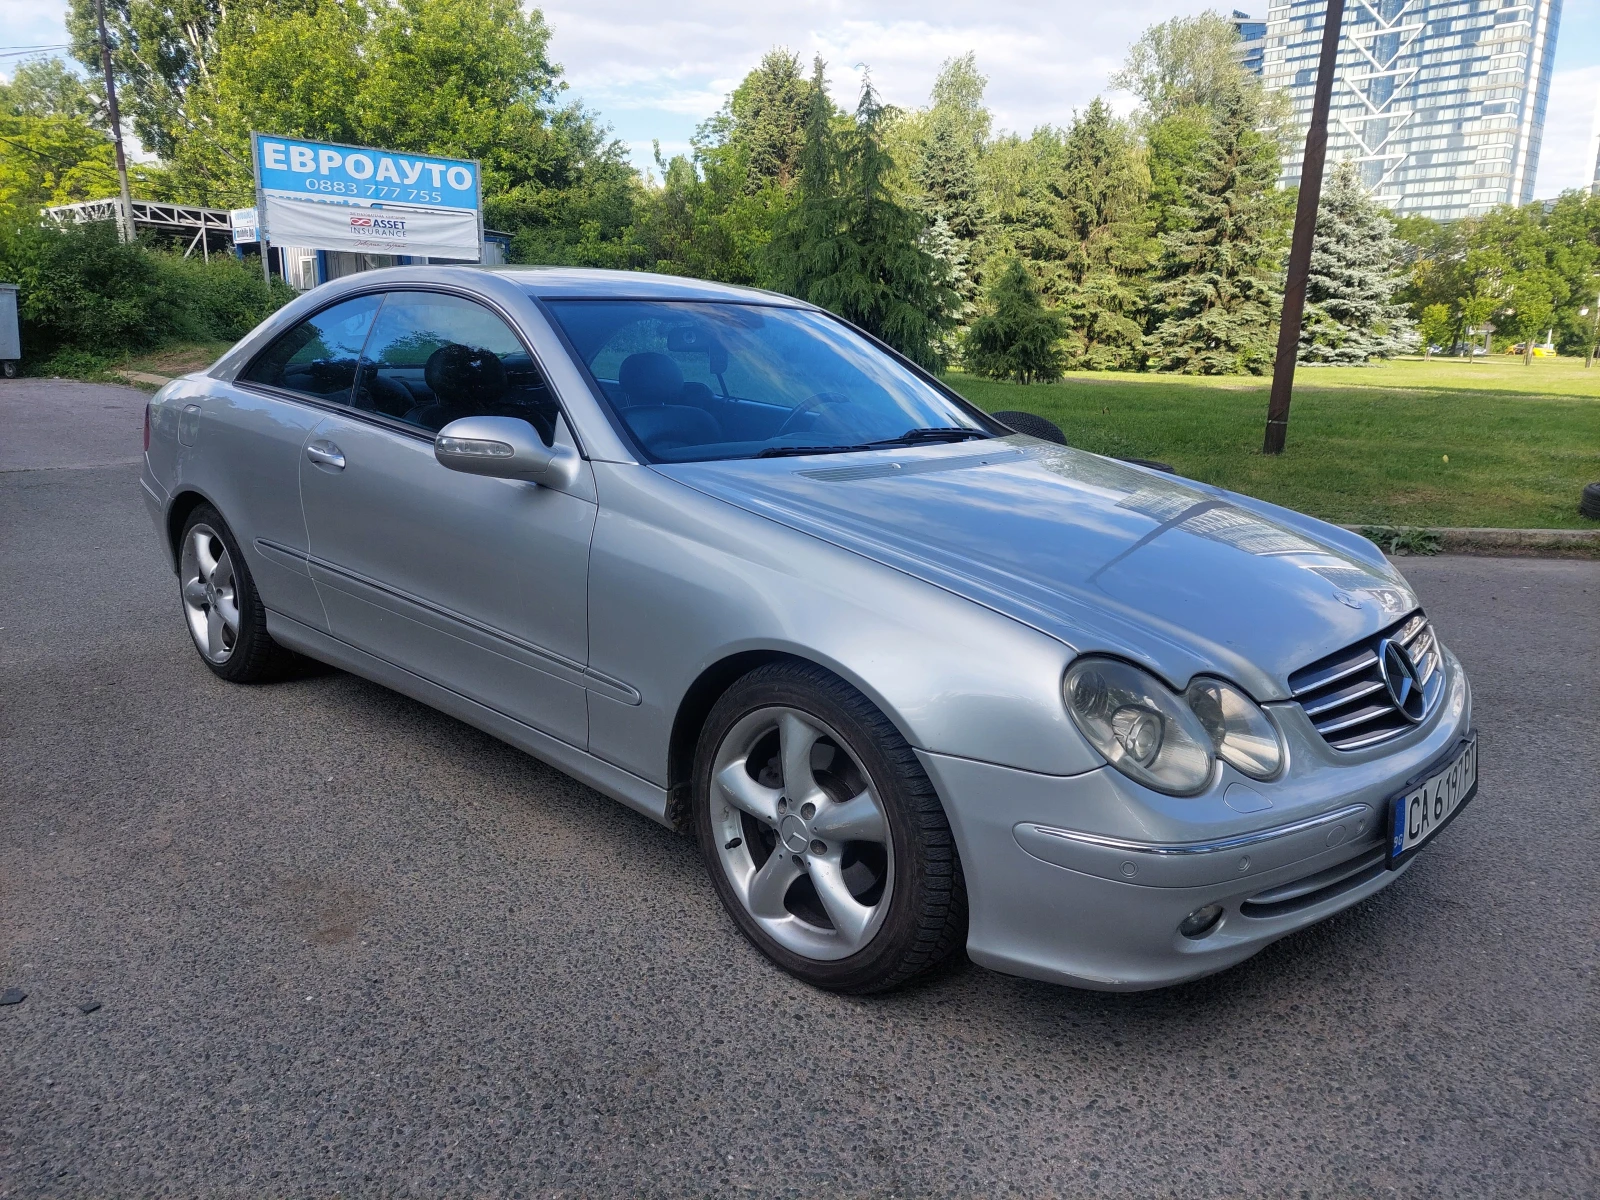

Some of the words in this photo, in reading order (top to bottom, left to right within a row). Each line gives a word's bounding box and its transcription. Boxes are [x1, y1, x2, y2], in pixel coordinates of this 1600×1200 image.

[263, 142, 473, 191] ЕВРОАУТО
[305, 178, 358, 194] 0883
[364, 184, 401, 198] 777
[407, 189, 442, 203] 755
[350, 226, 407, 238] INSURANCE
[373, 219, 406, 230] ASSET
[1409, 787, 1429, 840] CA
